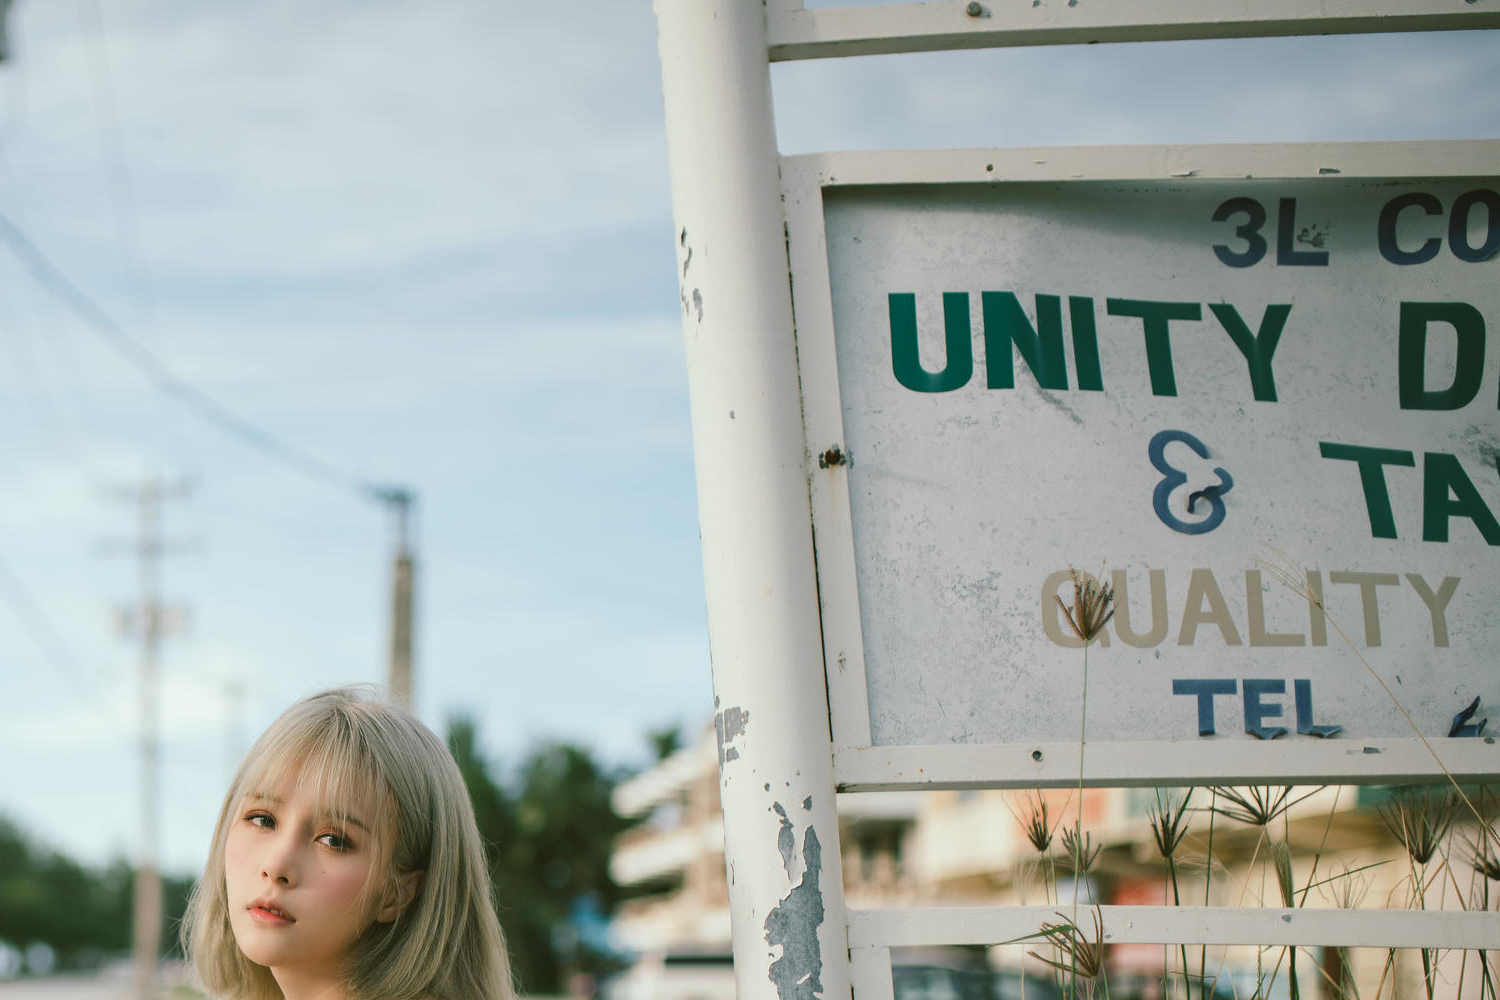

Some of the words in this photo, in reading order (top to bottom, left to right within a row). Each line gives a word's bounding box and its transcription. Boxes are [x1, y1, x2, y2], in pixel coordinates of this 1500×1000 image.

[1210, 195, 1330, 268] 3L
[1377, 188, 1500, 266] CO
[887, 290, 1293, 402] UNITY
[1398, 301, 1500, 412] D
[1148, 429, 1234, 535] &
[1318, 441, 1500, 547] TA
[1040, 567, 1462, 649] QUALITY
[1171, 678, 1343, 740] TEL
